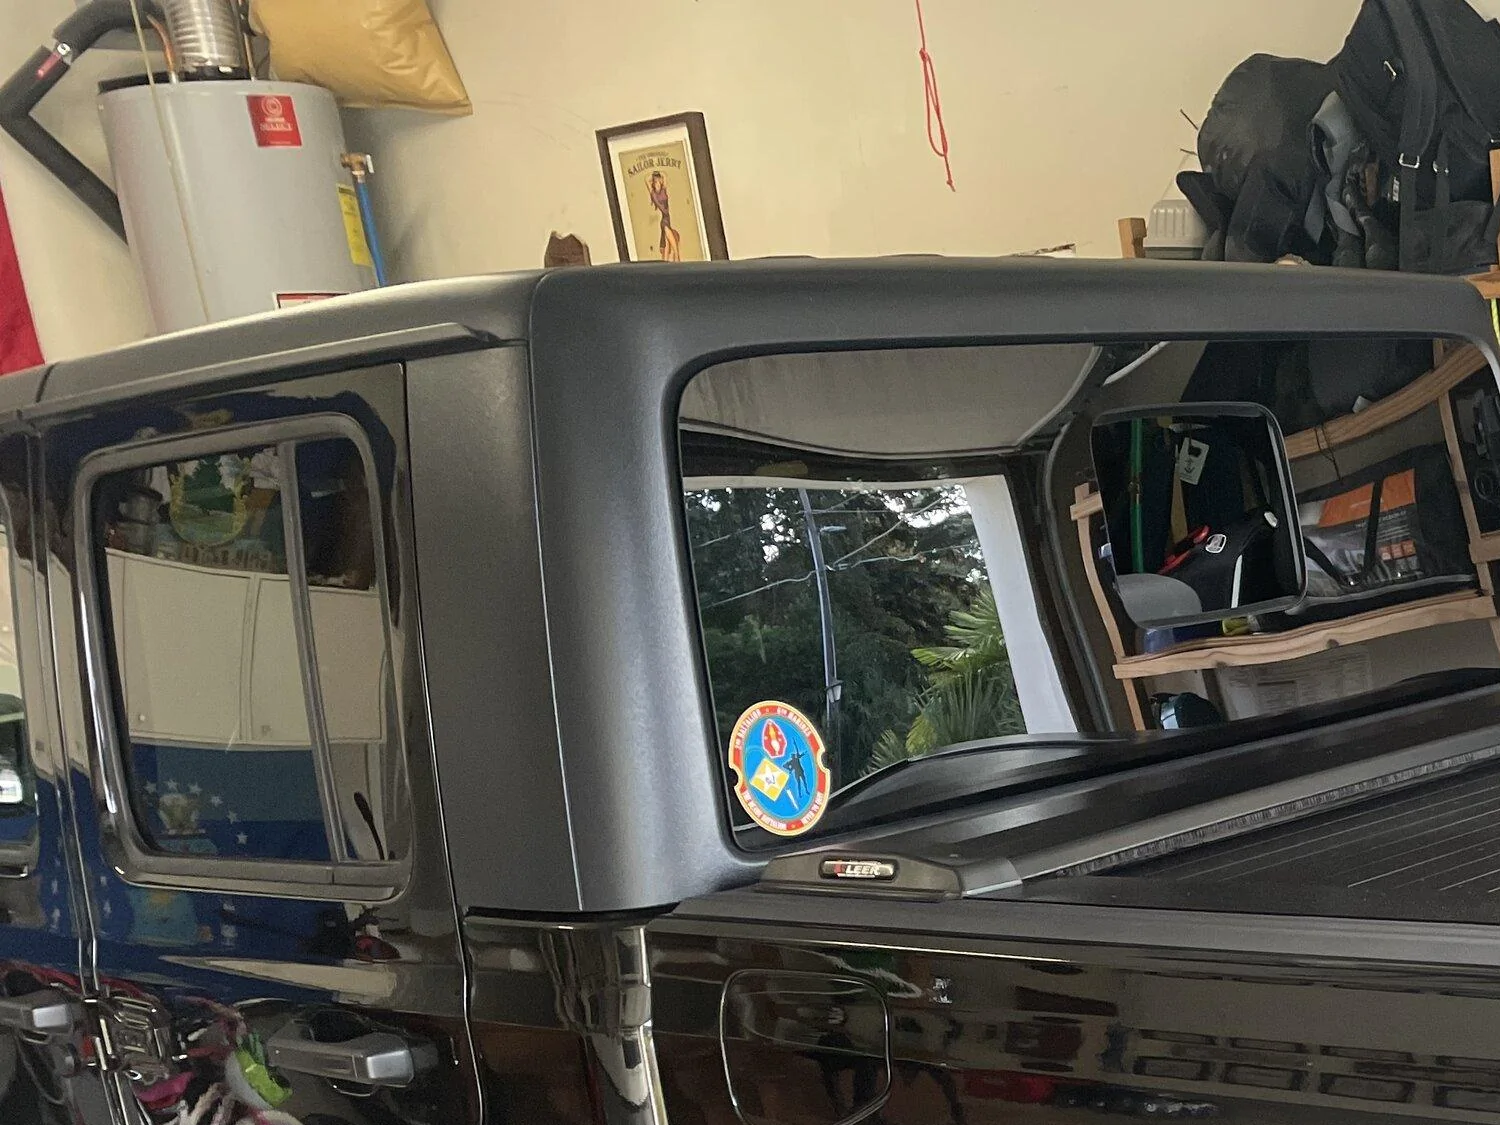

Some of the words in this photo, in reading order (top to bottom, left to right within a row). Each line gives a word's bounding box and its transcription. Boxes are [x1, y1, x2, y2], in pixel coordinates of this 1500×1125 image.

[627, 159, 654, 178] SAILOR
[656, 157, 682, 170] JERRY
[846, 864, 881, 876] LEER
